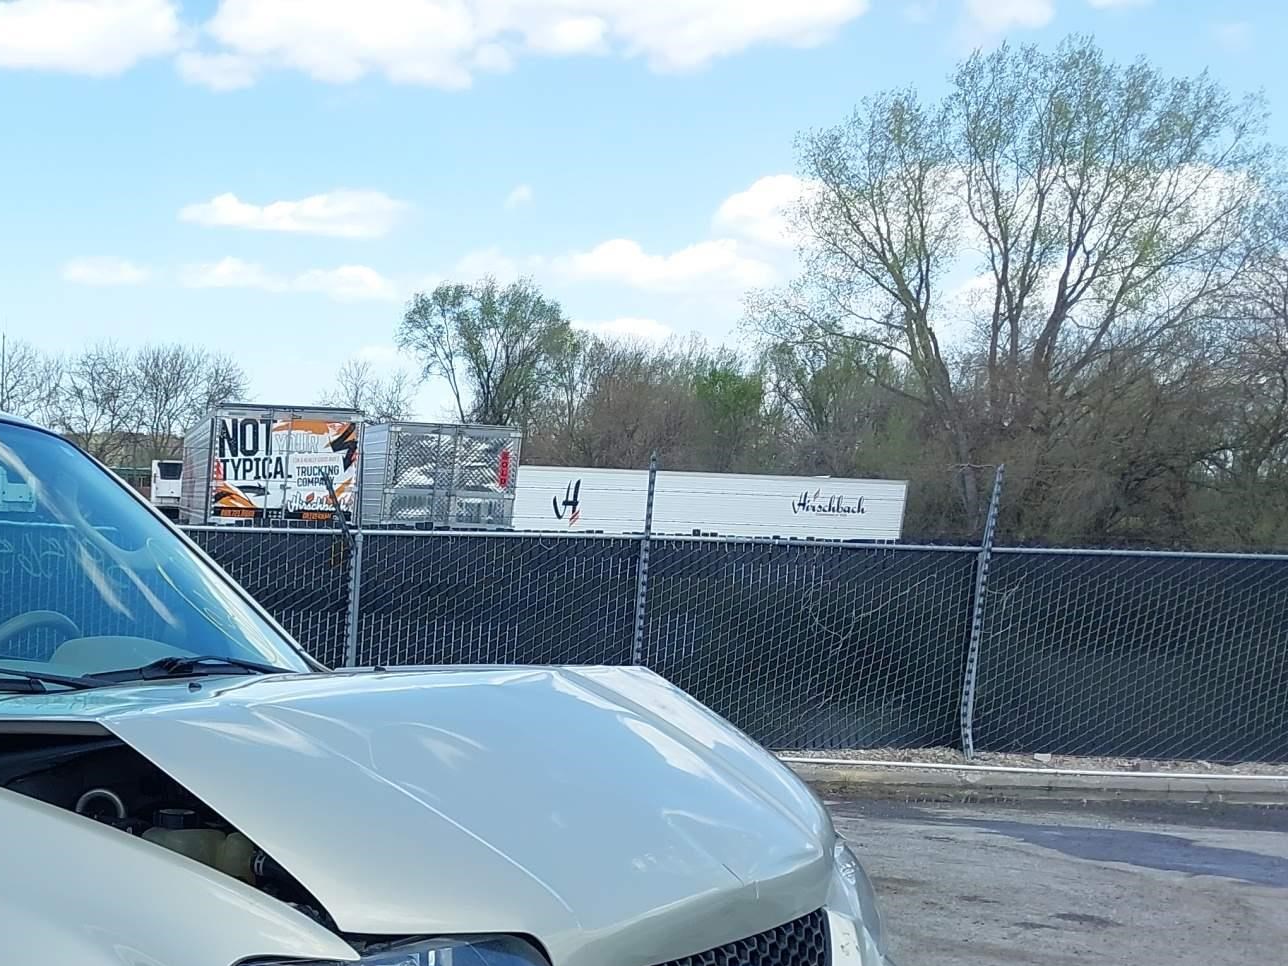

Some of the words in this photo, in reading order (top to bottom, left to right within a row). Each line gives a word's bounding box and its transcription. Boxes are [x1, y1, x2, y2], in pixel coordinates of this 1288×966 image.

[219, 418, 278, 458] NOT
[296, 465, 340, 478] TRUCKING
[297, 476, 337, 488] COMPAY.
[287, 491, 349, 512] Hirschbah
[792, 490, 866, 514] Hirschbach
